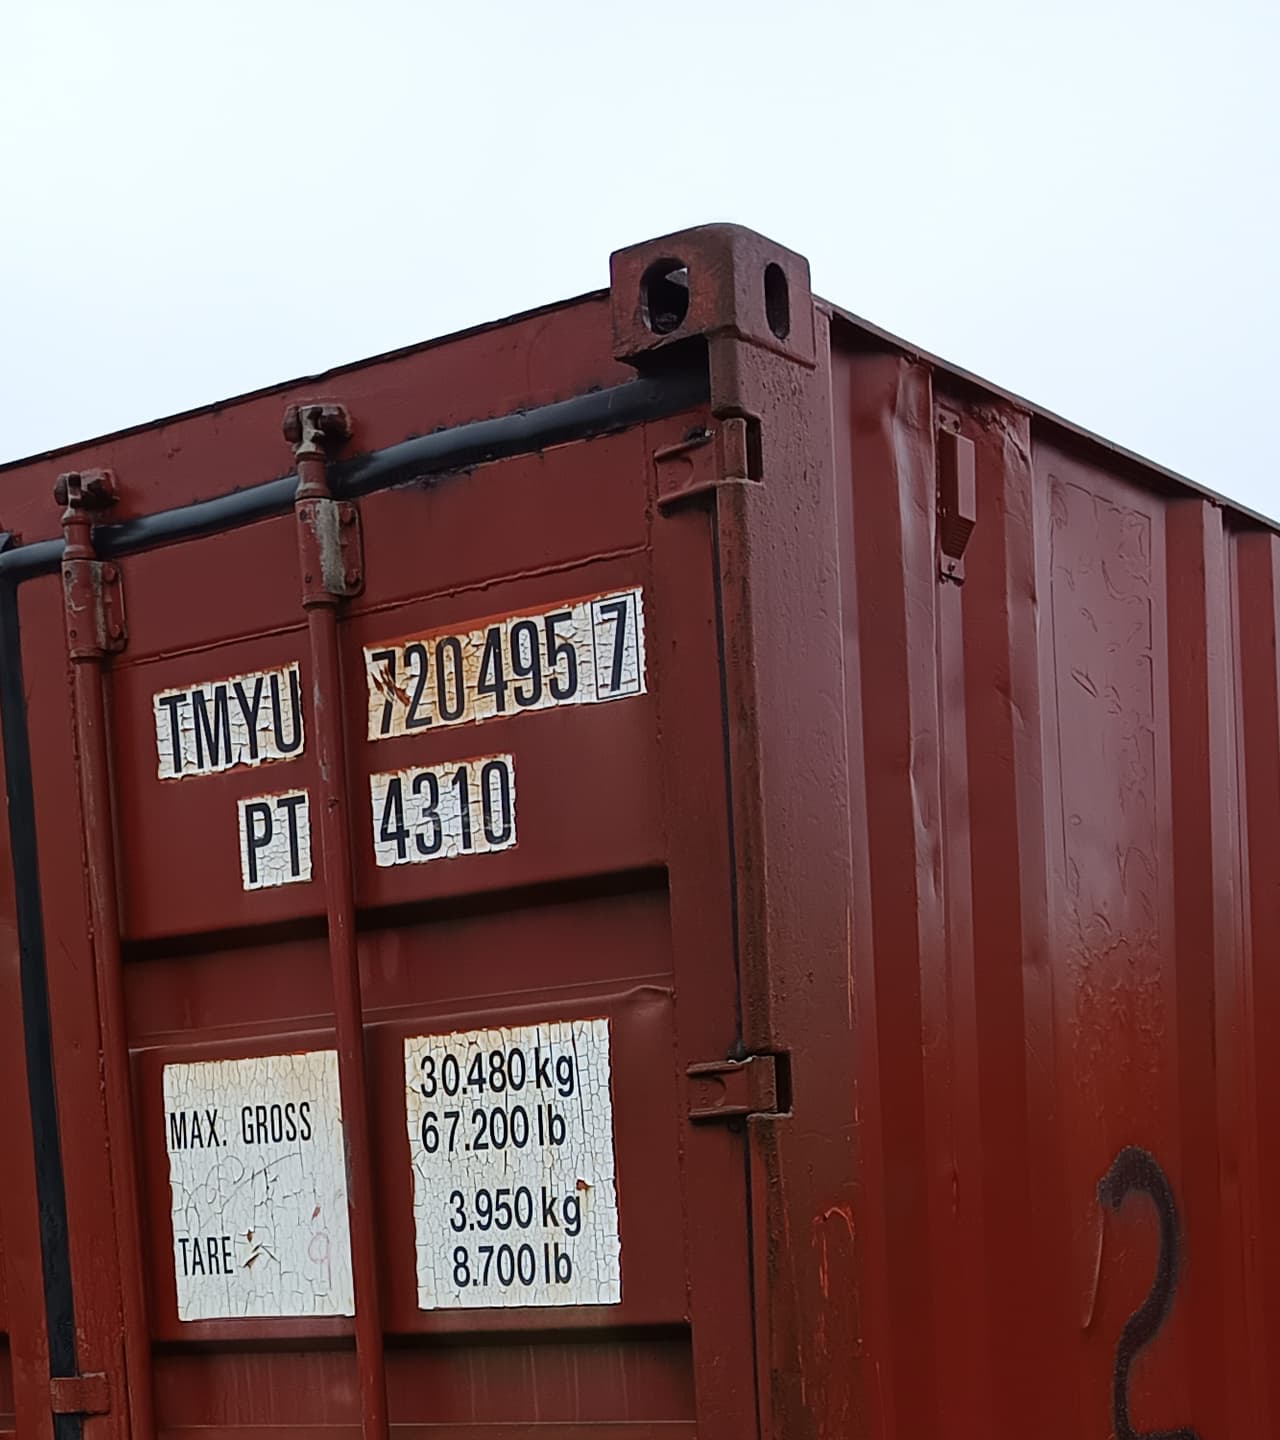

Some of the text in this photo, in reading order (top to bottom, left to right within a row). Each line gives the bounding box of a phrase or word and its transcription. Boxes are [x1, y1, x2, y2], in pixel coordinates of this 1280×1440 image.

[158, 601, 631, 774] TMYU 720495 7
[245, 760, 513, 884] PT 4310
[420, 1047, 575, 1098] 30.480 kg
[170, 1101, 313, 1150] MAX. GROSS
[421, 1103, 567, 1154] 67.200 lb
[449, 1186, 582, 1237] 3.950 kg
[178, 1236, 234, 1276] TARE
[452, 1242, 573, 1288] 8.700 lb
